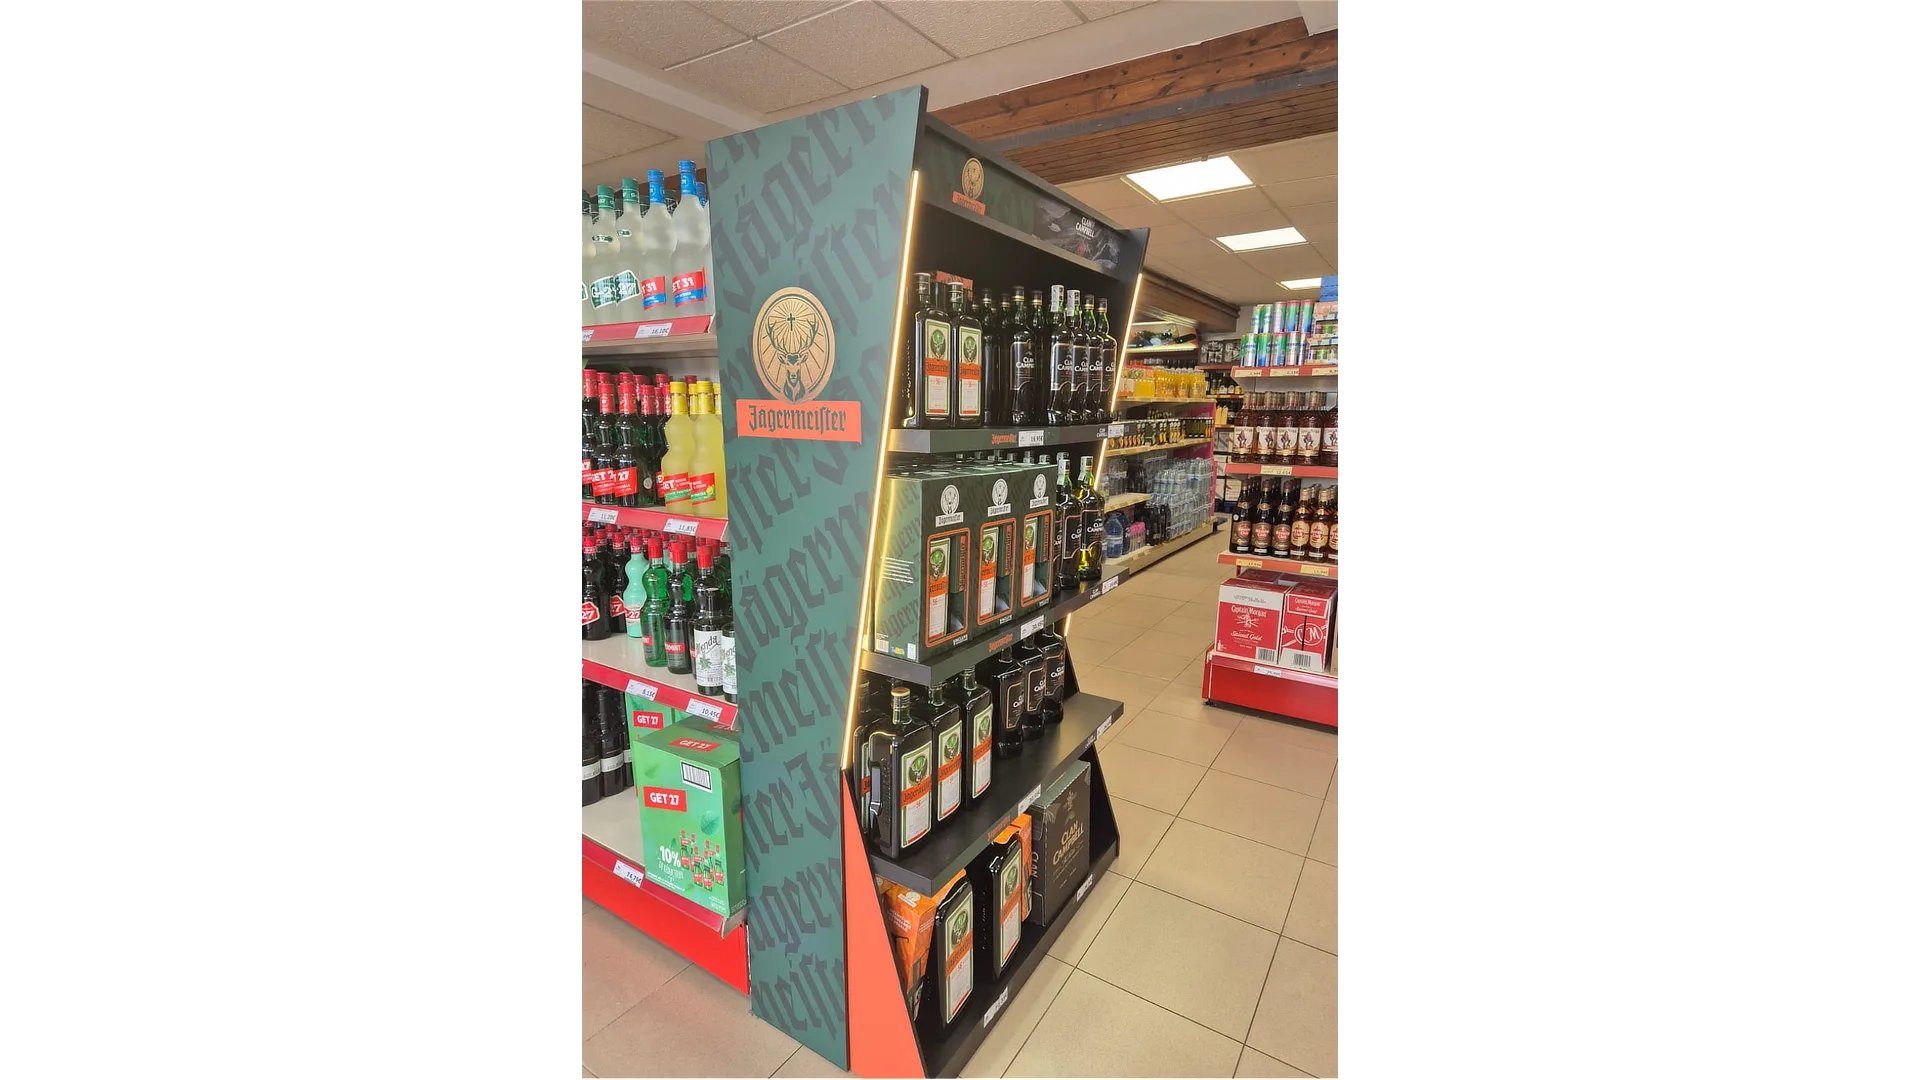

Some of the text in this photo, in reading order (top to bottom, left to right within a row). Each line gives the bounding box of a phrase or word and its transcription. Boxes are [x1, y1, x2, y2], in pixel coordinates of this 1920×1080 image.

[683, 276, 695, 287] 31
[618, 470, 629, 481] 27
[1231, 605, 1248, 615] Captain
[701, 708, 720, 718] 10,45€
[637, 715, 658, 725] GET 27
[650, 792, 679, 806] GET 27
[1061, 819, 1080, 845] CLAN
[1053, 822, 1085, 866] CAMPBELL
[660, 845, 681, 868] 10%
